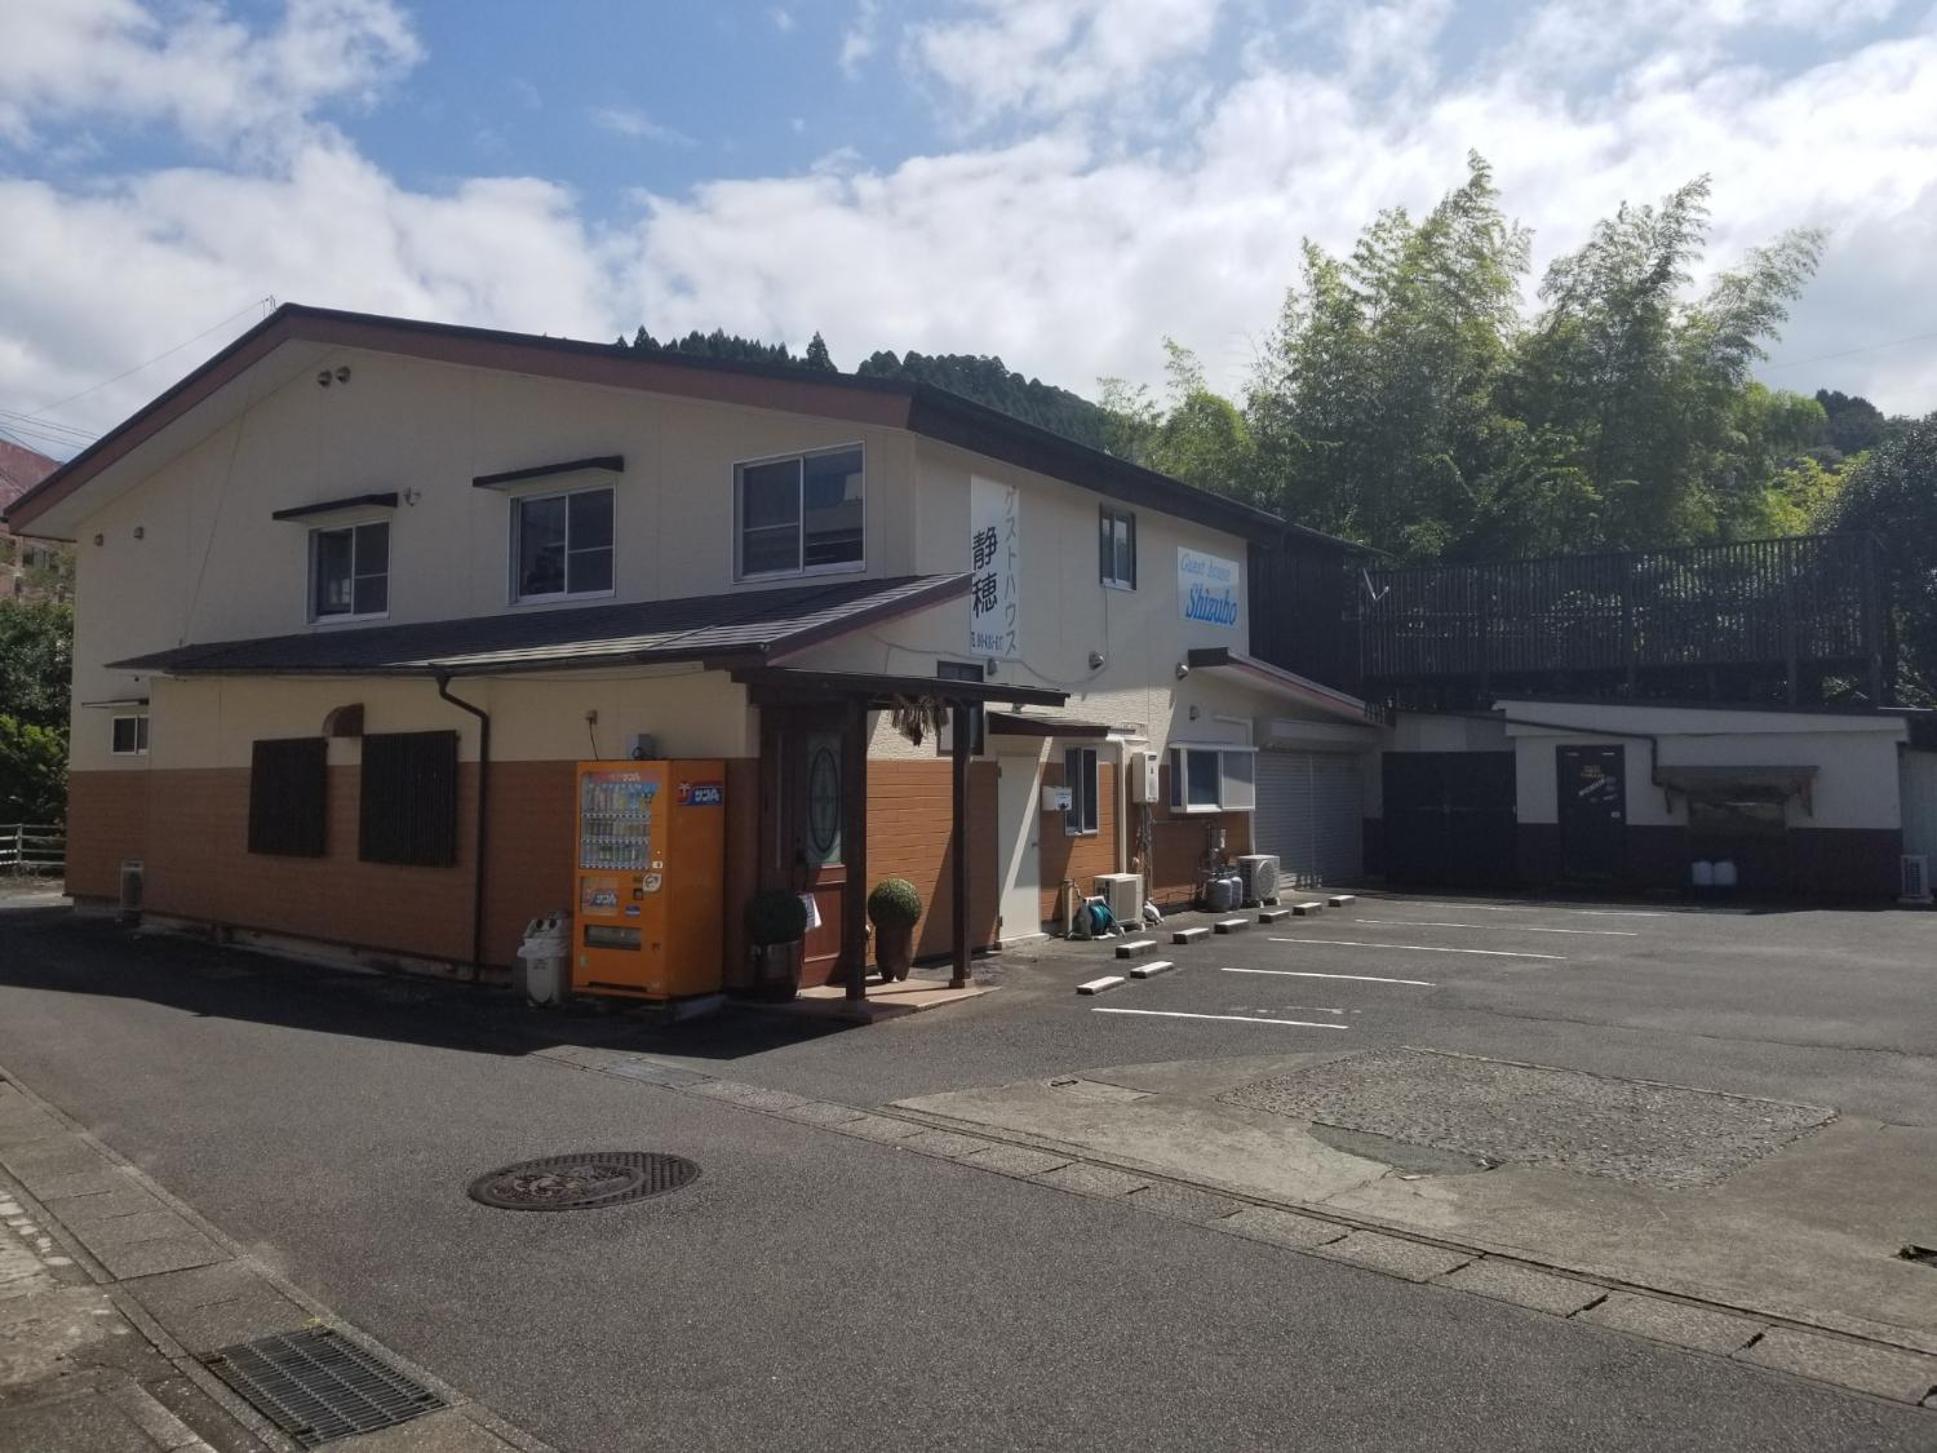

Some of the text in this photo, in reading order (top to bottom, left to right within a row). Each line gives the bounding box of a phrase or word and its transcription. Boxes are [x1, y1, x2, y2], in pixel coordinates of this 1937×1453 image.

[972, 527, 997, 618] 静穂
[1005, 485, 1017, 656] ゲストハウス
[1185, 584, 1237, 625] Shizuho
